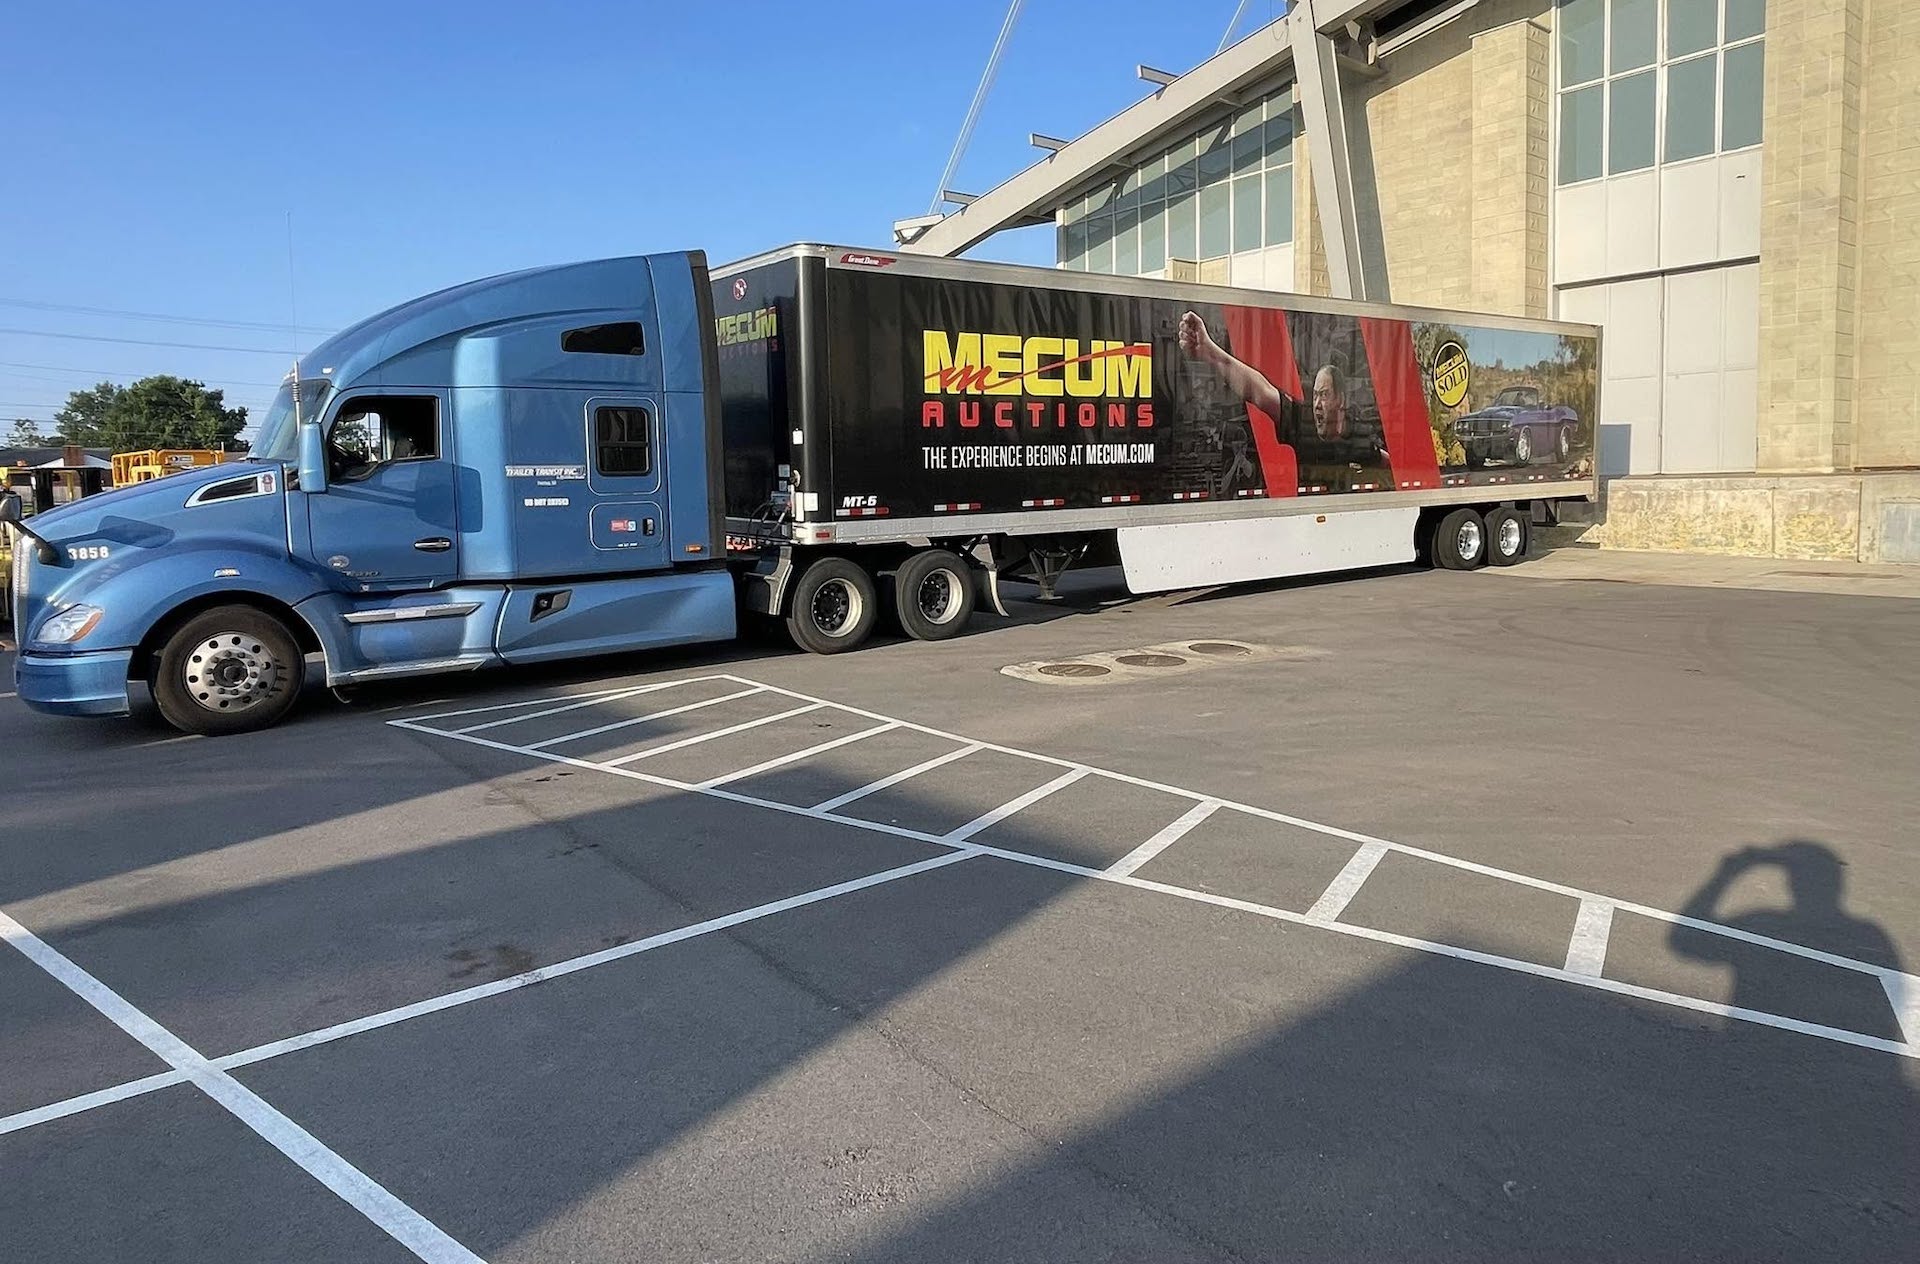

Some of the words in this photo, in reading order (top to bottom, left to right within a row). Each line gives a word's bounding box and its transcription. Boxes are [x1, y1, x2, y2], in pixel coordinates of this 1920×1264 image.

[923, 330, 1152, 398] MECUM
[1438, 365, 1467, 396] SOLD
[922, 401, 1154, 428] AUCTIONS
[922, 446, 947, 469] THE
[951, 445, 1022, 468] EXPERIENCE
[1026, 444, 1066, 466] BEGINS
[1070, 444, 1082, 465] AT
[1086, 443, 1154, 465] MECUM.COM
[842, 495, 878, 508] MT-6
[68, 546, 110, 560] 3858
